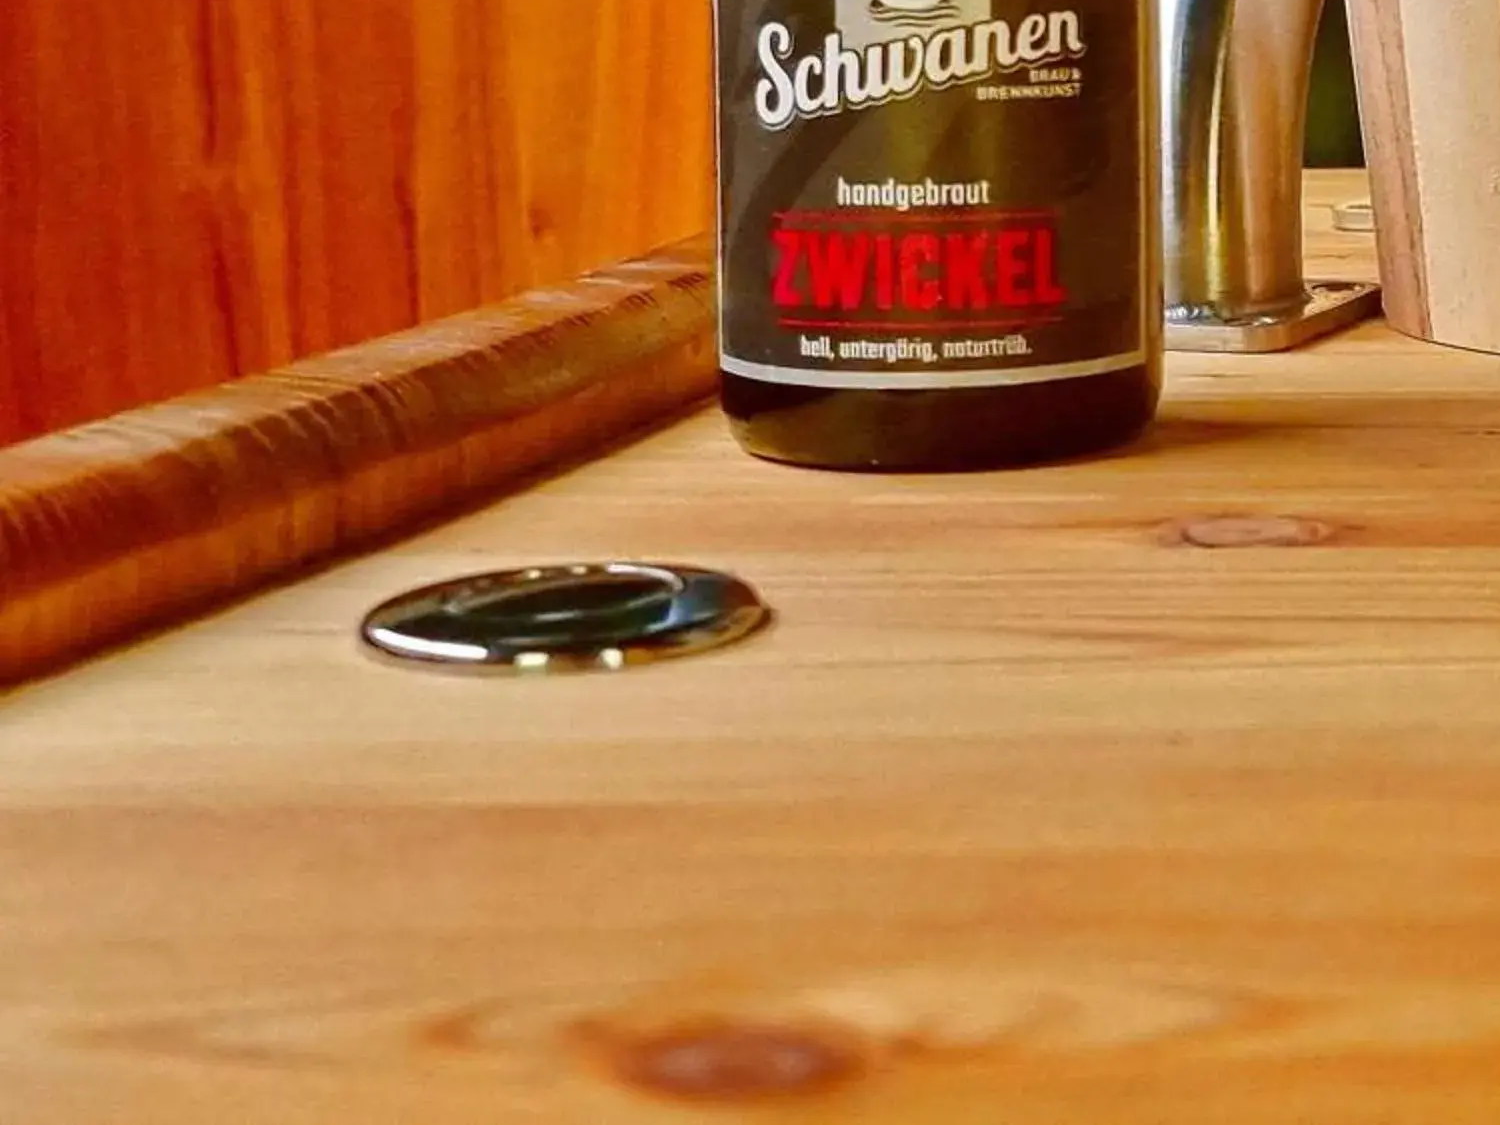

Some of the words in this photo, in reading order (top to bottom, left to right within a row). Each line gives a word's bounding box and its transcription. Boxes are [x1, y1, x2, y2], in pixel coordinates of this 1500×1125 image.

[755, 9, 1087, 131] Schwanen
[836, 178, 990, 208] handgebraut
[771, 228, 1066, 312] ZWICKEL
[800, 334, 835, 361] hell,
